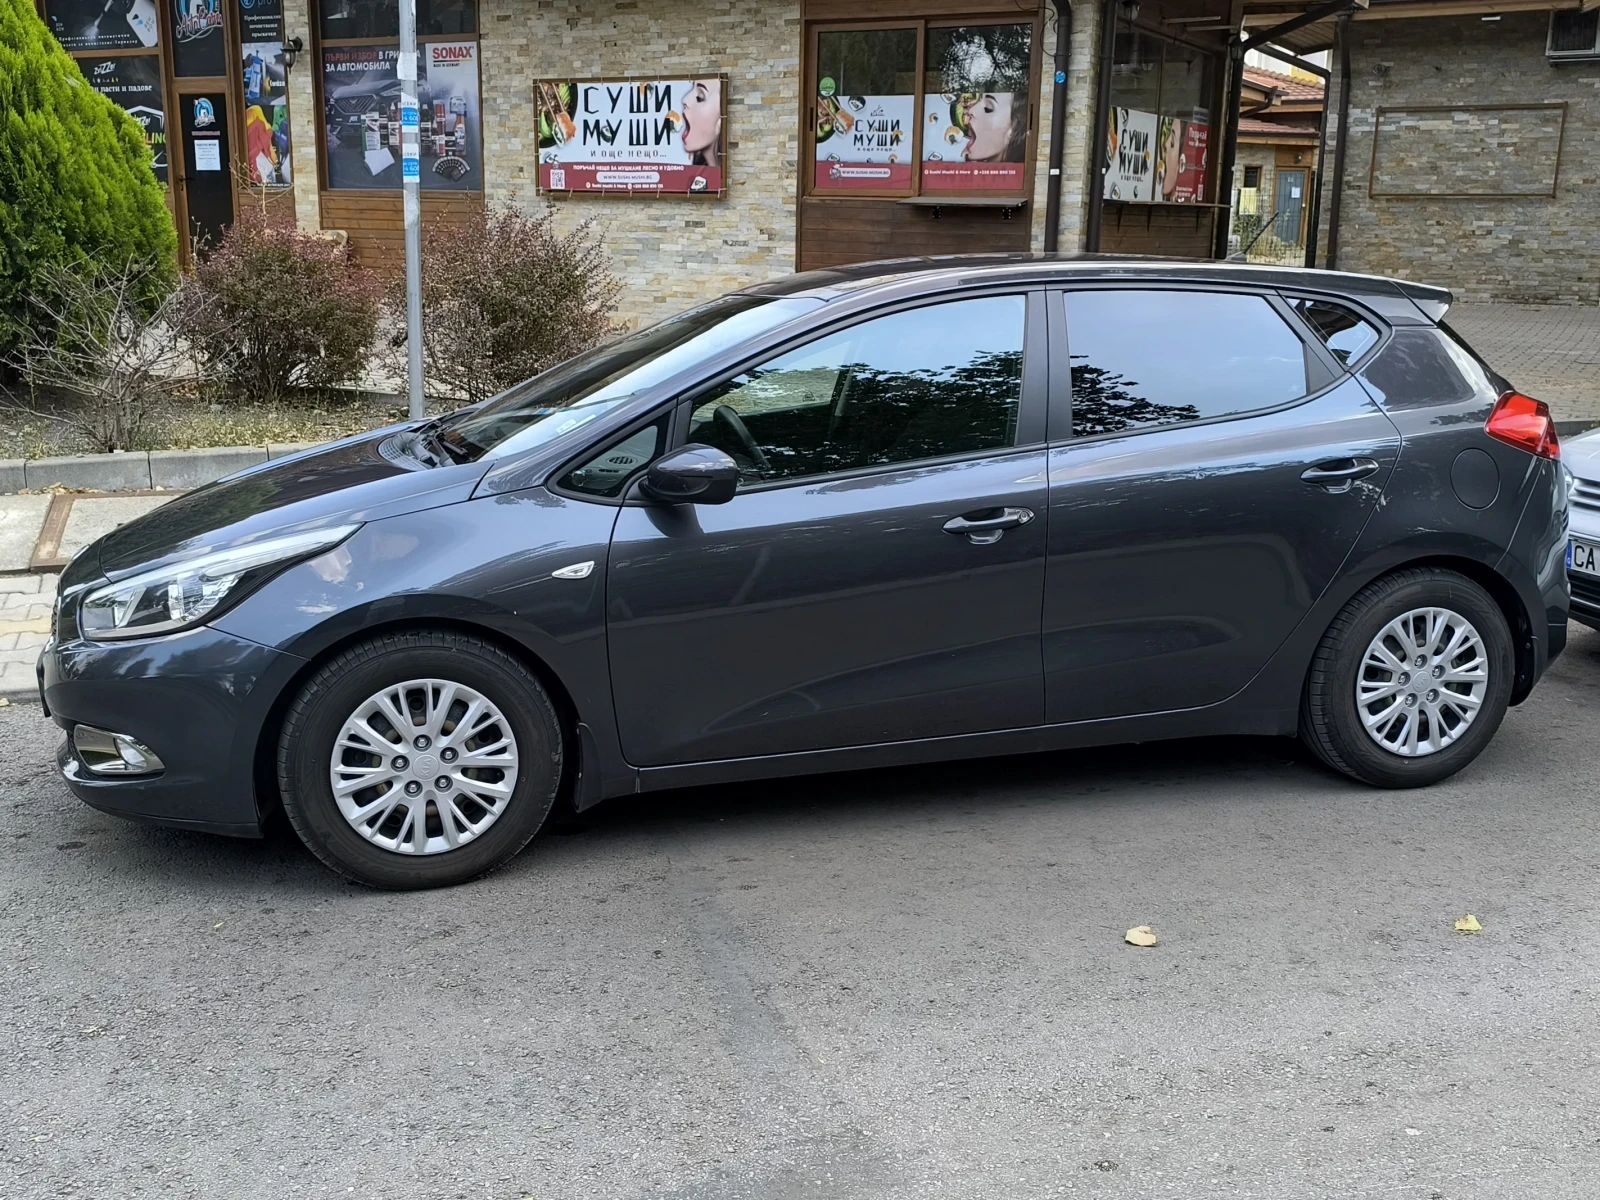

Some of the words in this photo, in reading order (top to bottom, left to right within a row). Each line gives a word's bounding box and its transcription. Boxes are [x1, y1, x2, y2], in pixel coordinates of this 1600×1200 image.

[325, 52, 350, 62] ПЪРВИ
[351, 51, 377, 61] ИЗБОР
[378, 51, 383, 60] В
[432, 46, 473, 60] SONAX
[325, 63, 336, 73] ЗА
[336, 61, 391, 72] АВТОМОБИЛА
[128, 84, 152, 92] падове
[584, 84, 672, 115] СУШИ
[583, 118, 671, 146] МУШИ
[854, 119, 900, 133] СУШИ
[853, 133, 899, 147] МУШИ
[1121, 128, 1149, 153] СУШИ
[601, 150, 623, 159] още
[1119, 151, 1148, 176] МУШИ
[1574, 544, 1596, 571] CA
